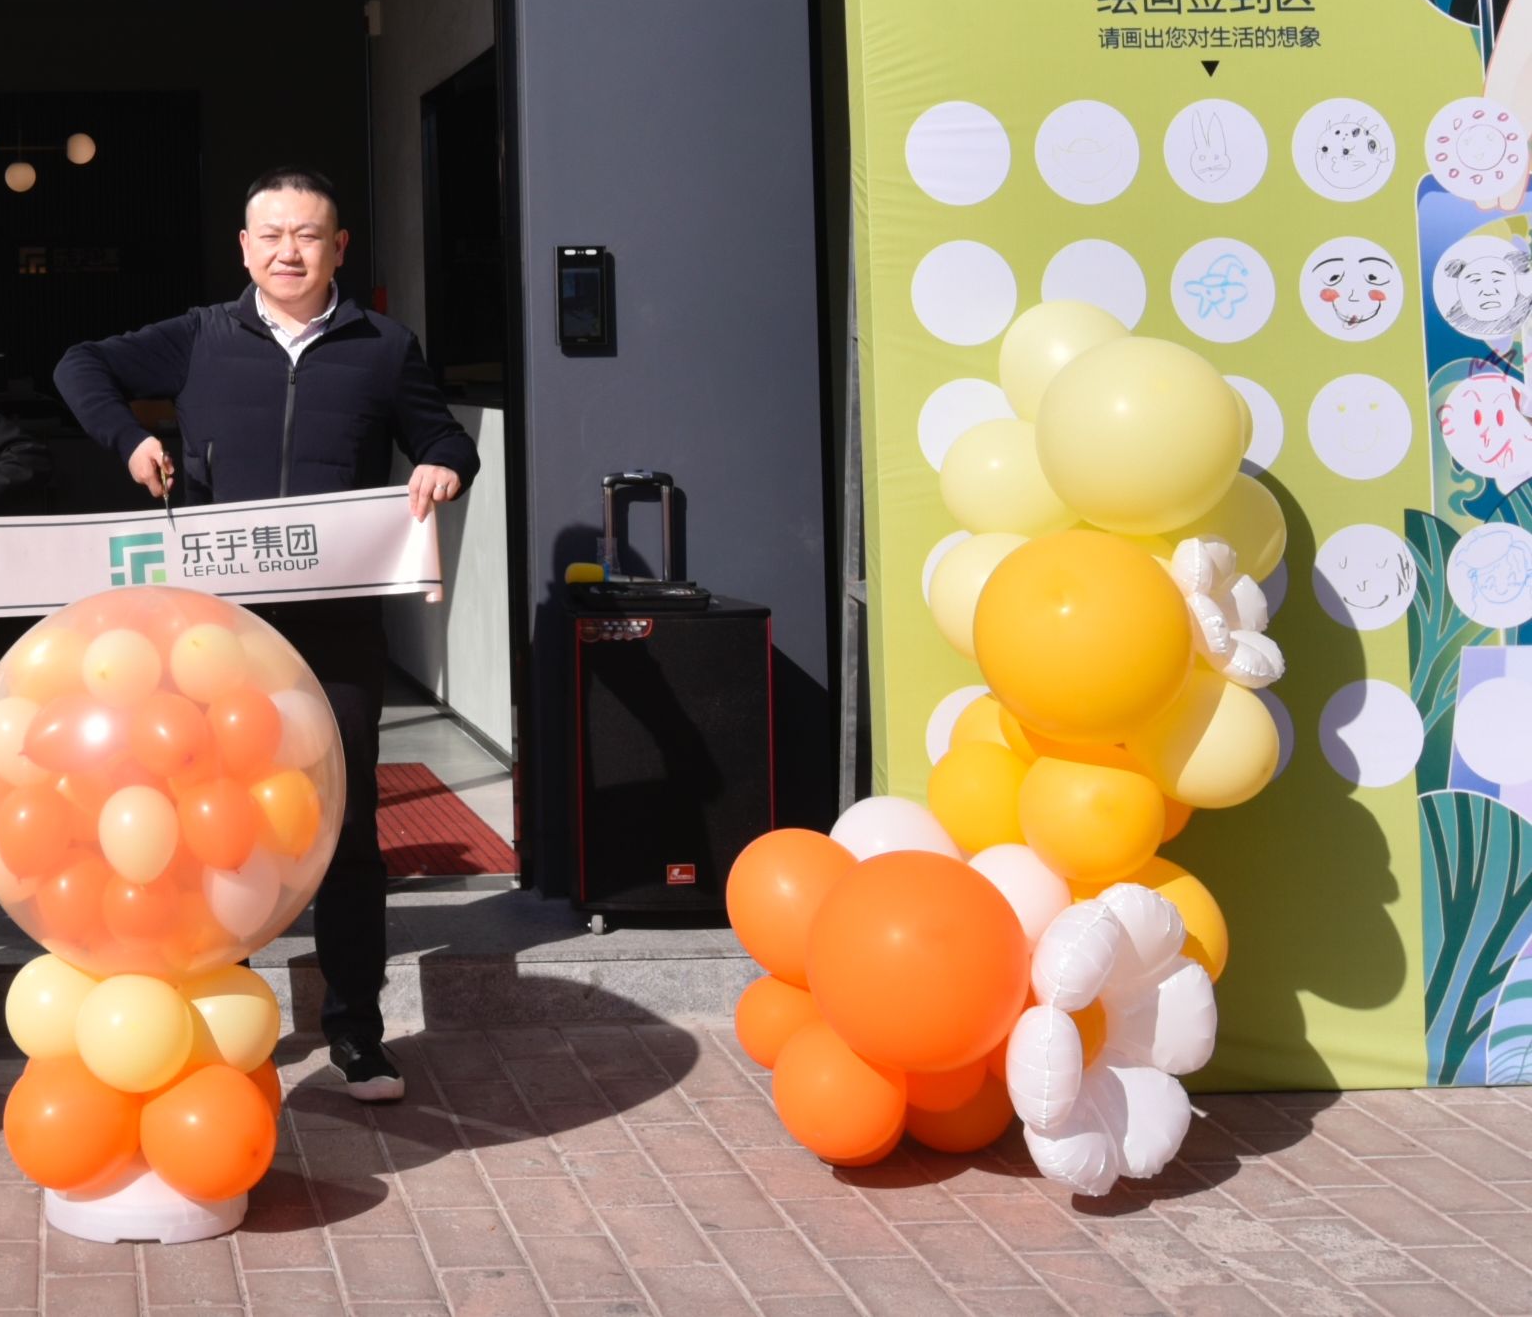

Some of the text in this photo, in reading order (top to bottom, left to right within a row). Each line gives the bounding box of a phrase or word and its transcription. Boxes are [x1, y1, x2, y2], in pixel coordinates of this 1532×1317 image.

[1098, 26, 1322, 49] 请画出您对生活的想象
[181, 523, 318, 565] 乐乎集团
[184, 558, 319, 578] LEFULL GROUP
